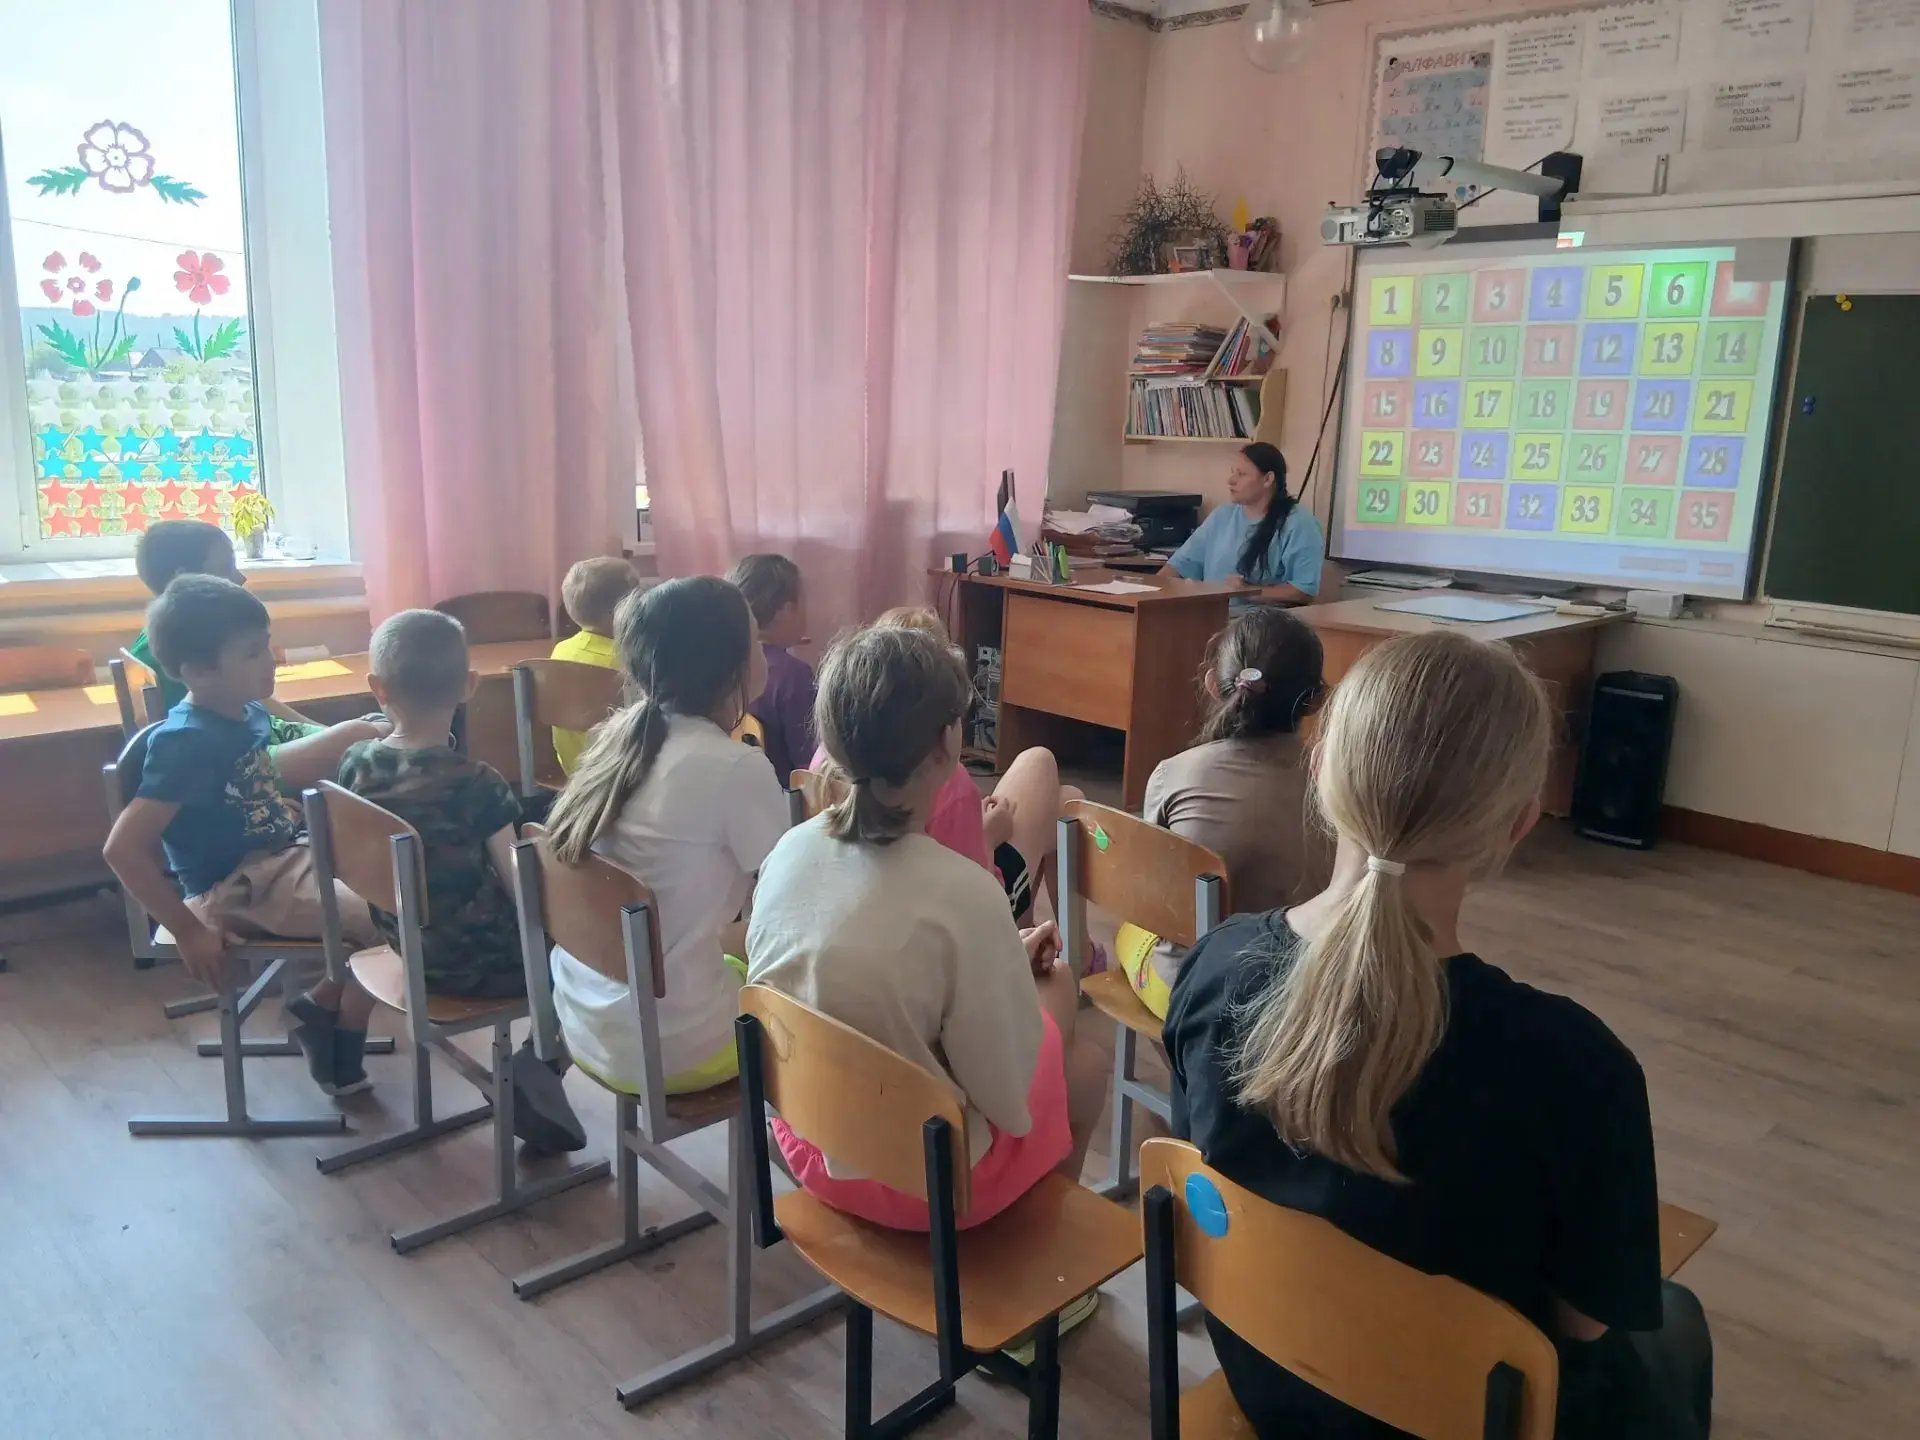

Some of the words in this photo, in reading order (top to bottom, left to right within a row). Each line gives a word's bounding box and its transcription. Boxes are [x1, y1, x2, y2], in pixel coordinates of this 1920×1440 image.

[1384, 286, 1396, 314] 1
[1435, 283, 1450, 312] 2
[1489, 281, 1506, 310] 3
[1547, 277, 1564, 308] 4
[1604, 274, 1624, 306] 5
[1667, 272, 1686, 305] 6
[1380, 340, 1394, 366] 8
[1432, 338, 1446, 366] 9
[1478, 336, 1506, 364] 10
[1533, 336, 1563, 364] 11
[1592, 334, 1622, 364] 12
[1652, 332, 1684, 364] 13
[1714, 332, 1748, 364] 14
[1372, 390, 1396, 416] 15
[1422, 390, 1448, 418] 16
[1474, 389, 1502, 418] 17
[1528, 390, 1556, 418] 18
[1585, 390, 1614, 418] 19
[1642, 390, 1676, 420] 20
[1704, 390, 1736, 421] 21
[1368, 440, 1394, 466] 22
[1418, 441, 1444, 466] 23
[1470, 441, 1496, 468] 24
[1520, 442, 1550, 470] 25
[1577, 444, 1608, 472] 26
[1636, 445, 1669, 472] 27
[1696, 446, 1730, 476] 28
[1366, 488, 1390, 513] 29
[1413, 490, 1440, 516] 30
[1466, 493, 1492, 518] 31
[1517, 494, 1542, 520] 32
[1570, 496, 1600, 523] 33
[1628, 498, 1658, 526] 34
[1688, 502, 1720, 530] 35
